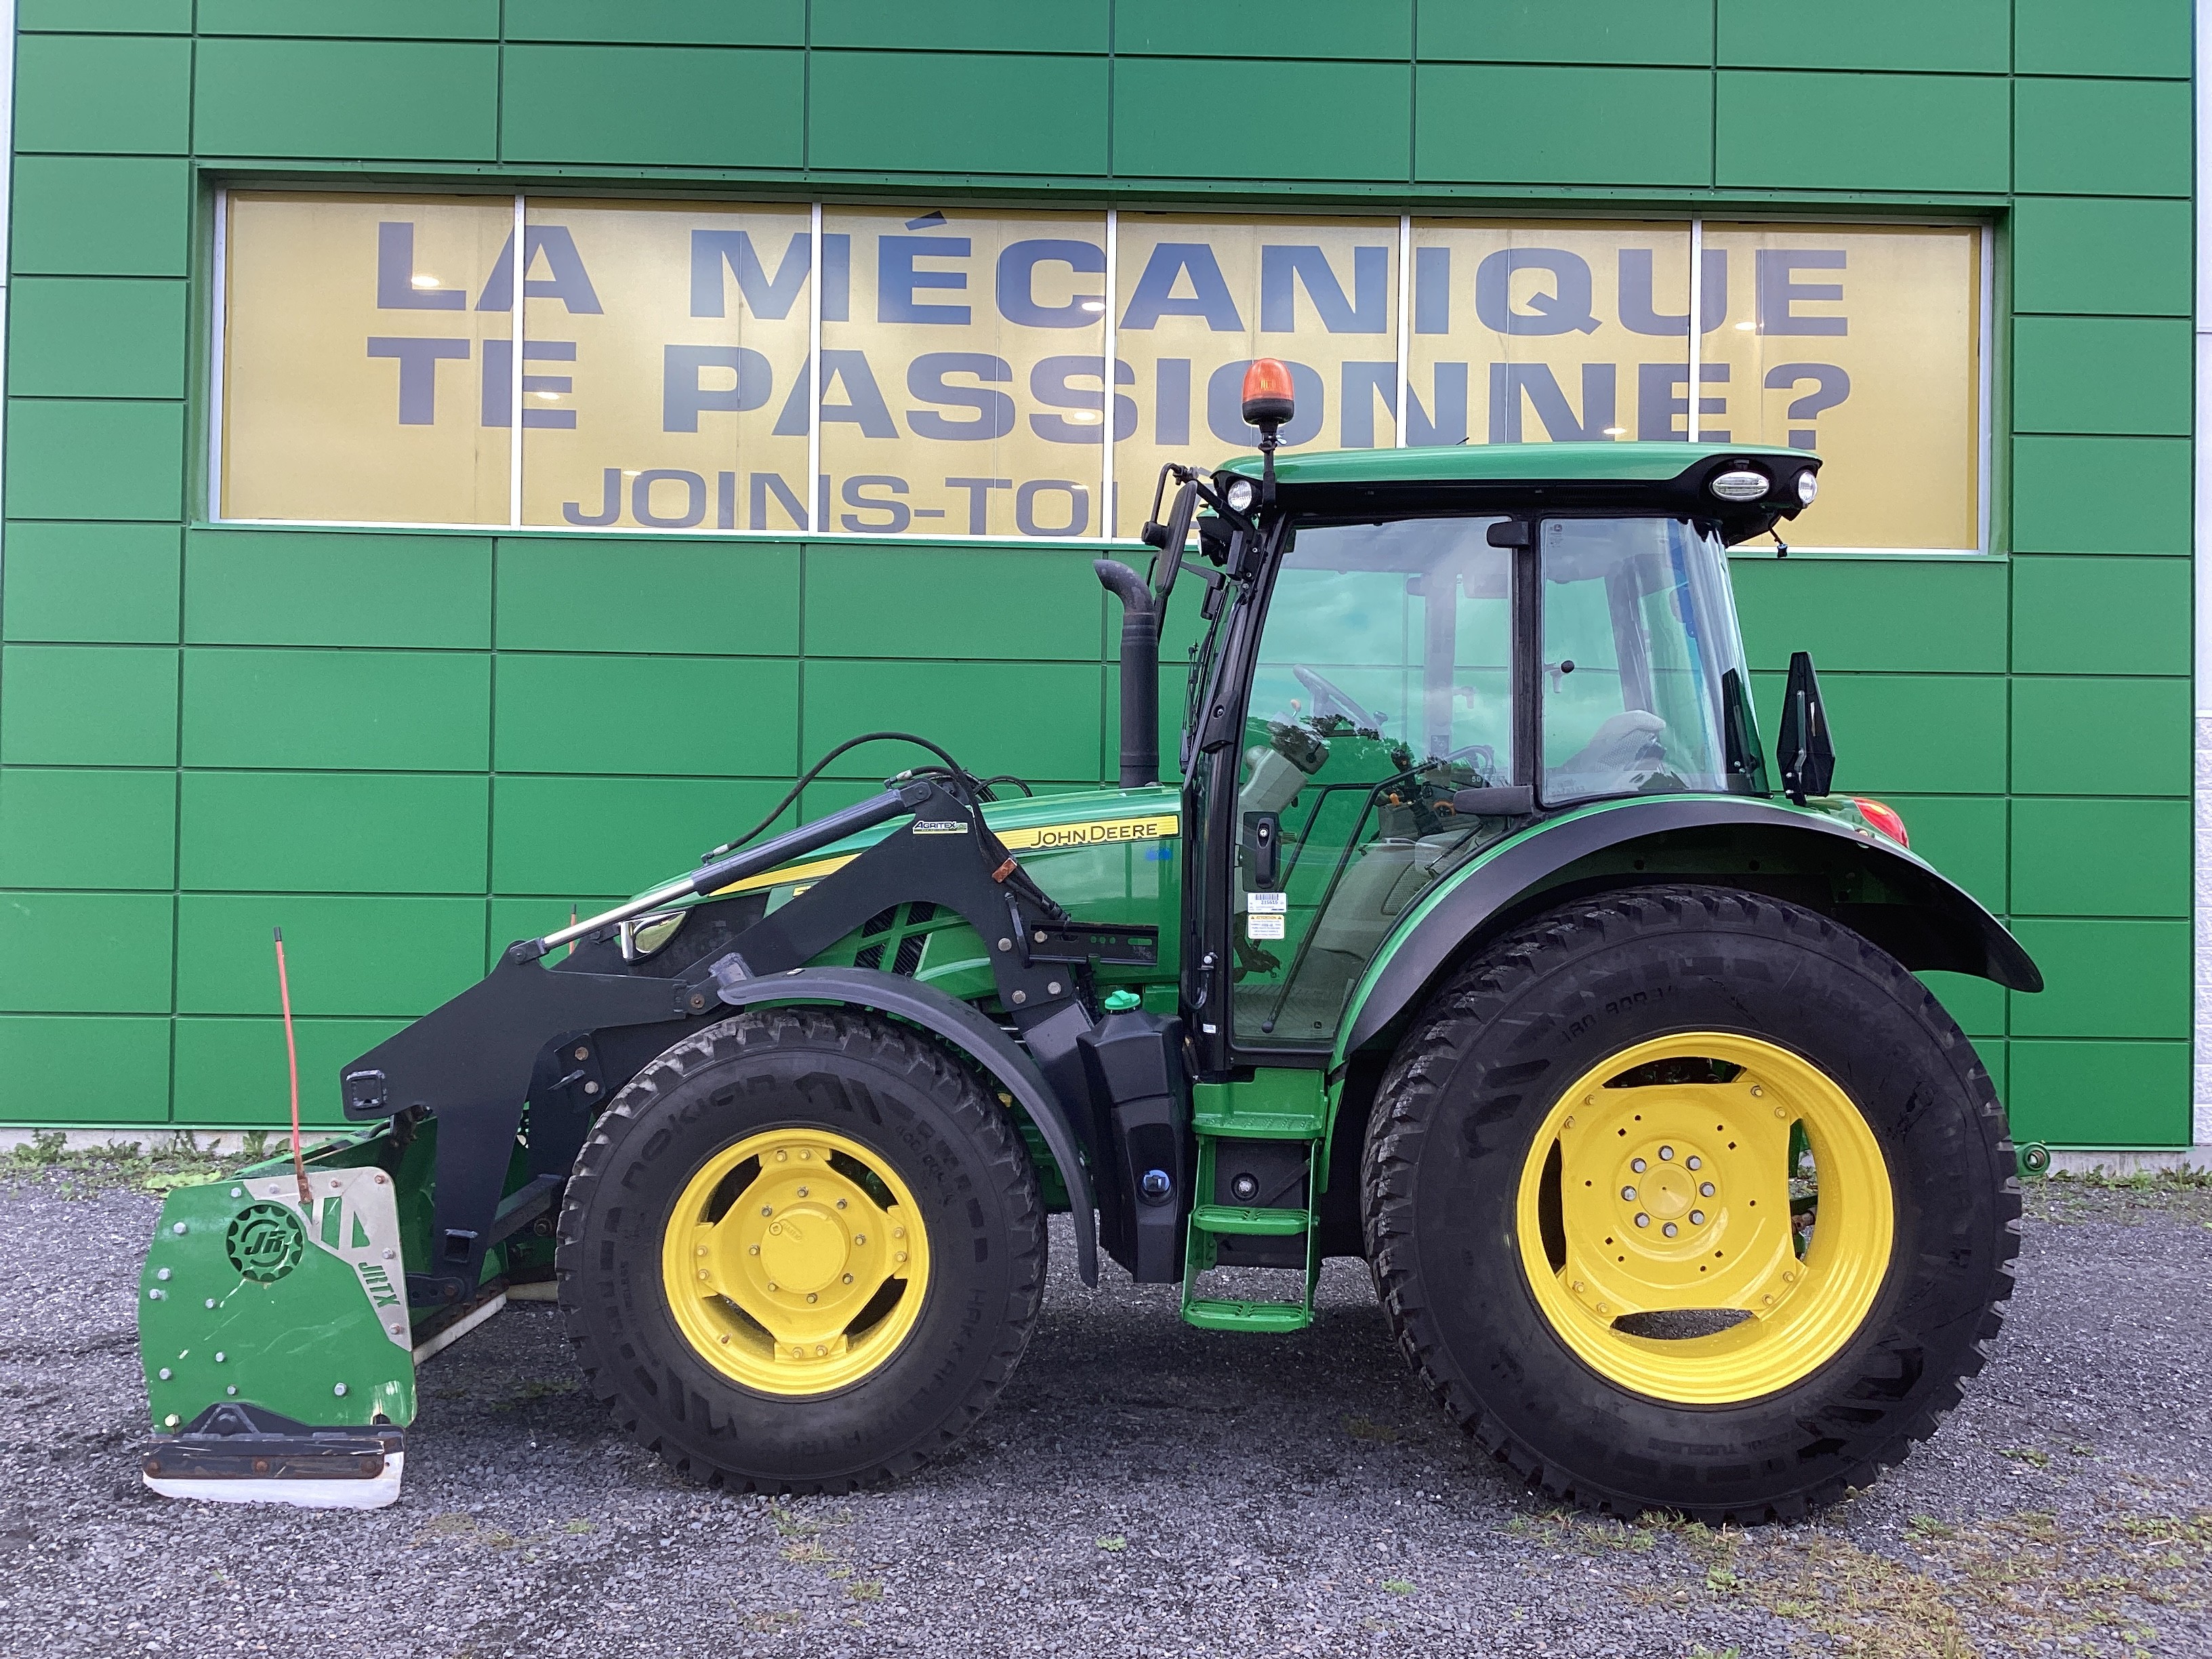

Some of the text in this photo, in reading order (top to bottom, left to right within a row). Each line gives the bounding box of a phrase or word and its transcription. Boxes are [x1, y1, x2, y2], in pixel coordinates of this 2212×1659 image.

[377, 210, 1849, 337] LA MÉCANIQUE
[367, 336, 1851, 450] TE PASSIONNE?
[1030, 823, 1158, 846] JOHN DEERE
[358, 1262, 401, 1309] JRTX
